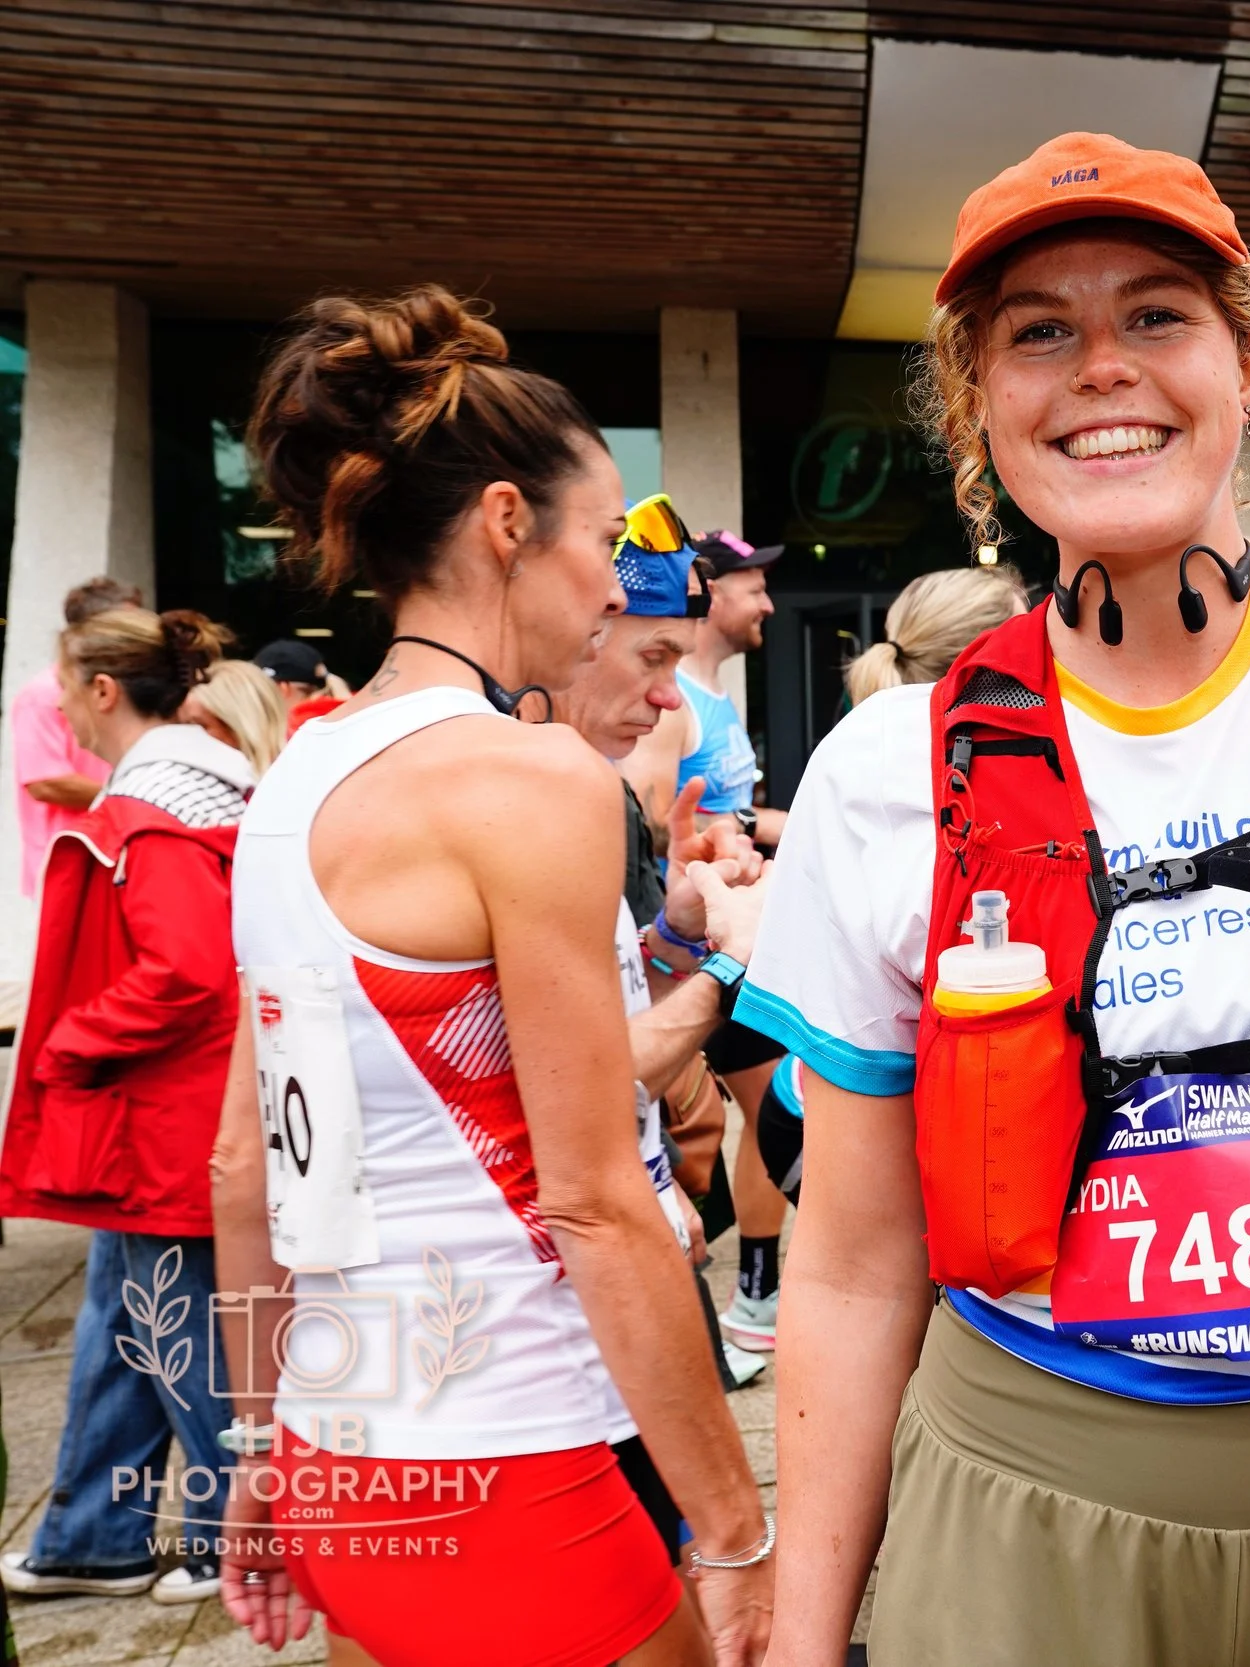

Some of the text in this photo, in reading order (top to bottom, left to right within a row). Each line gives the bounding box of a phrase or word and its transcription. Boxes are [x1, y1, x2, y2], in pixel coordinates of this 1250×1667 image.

[1091, 965, 1184, 1011] ales
[1190, 1128, 1226, 1140] HANNER
[1068, 1174, 1149, 1215] YDIA
